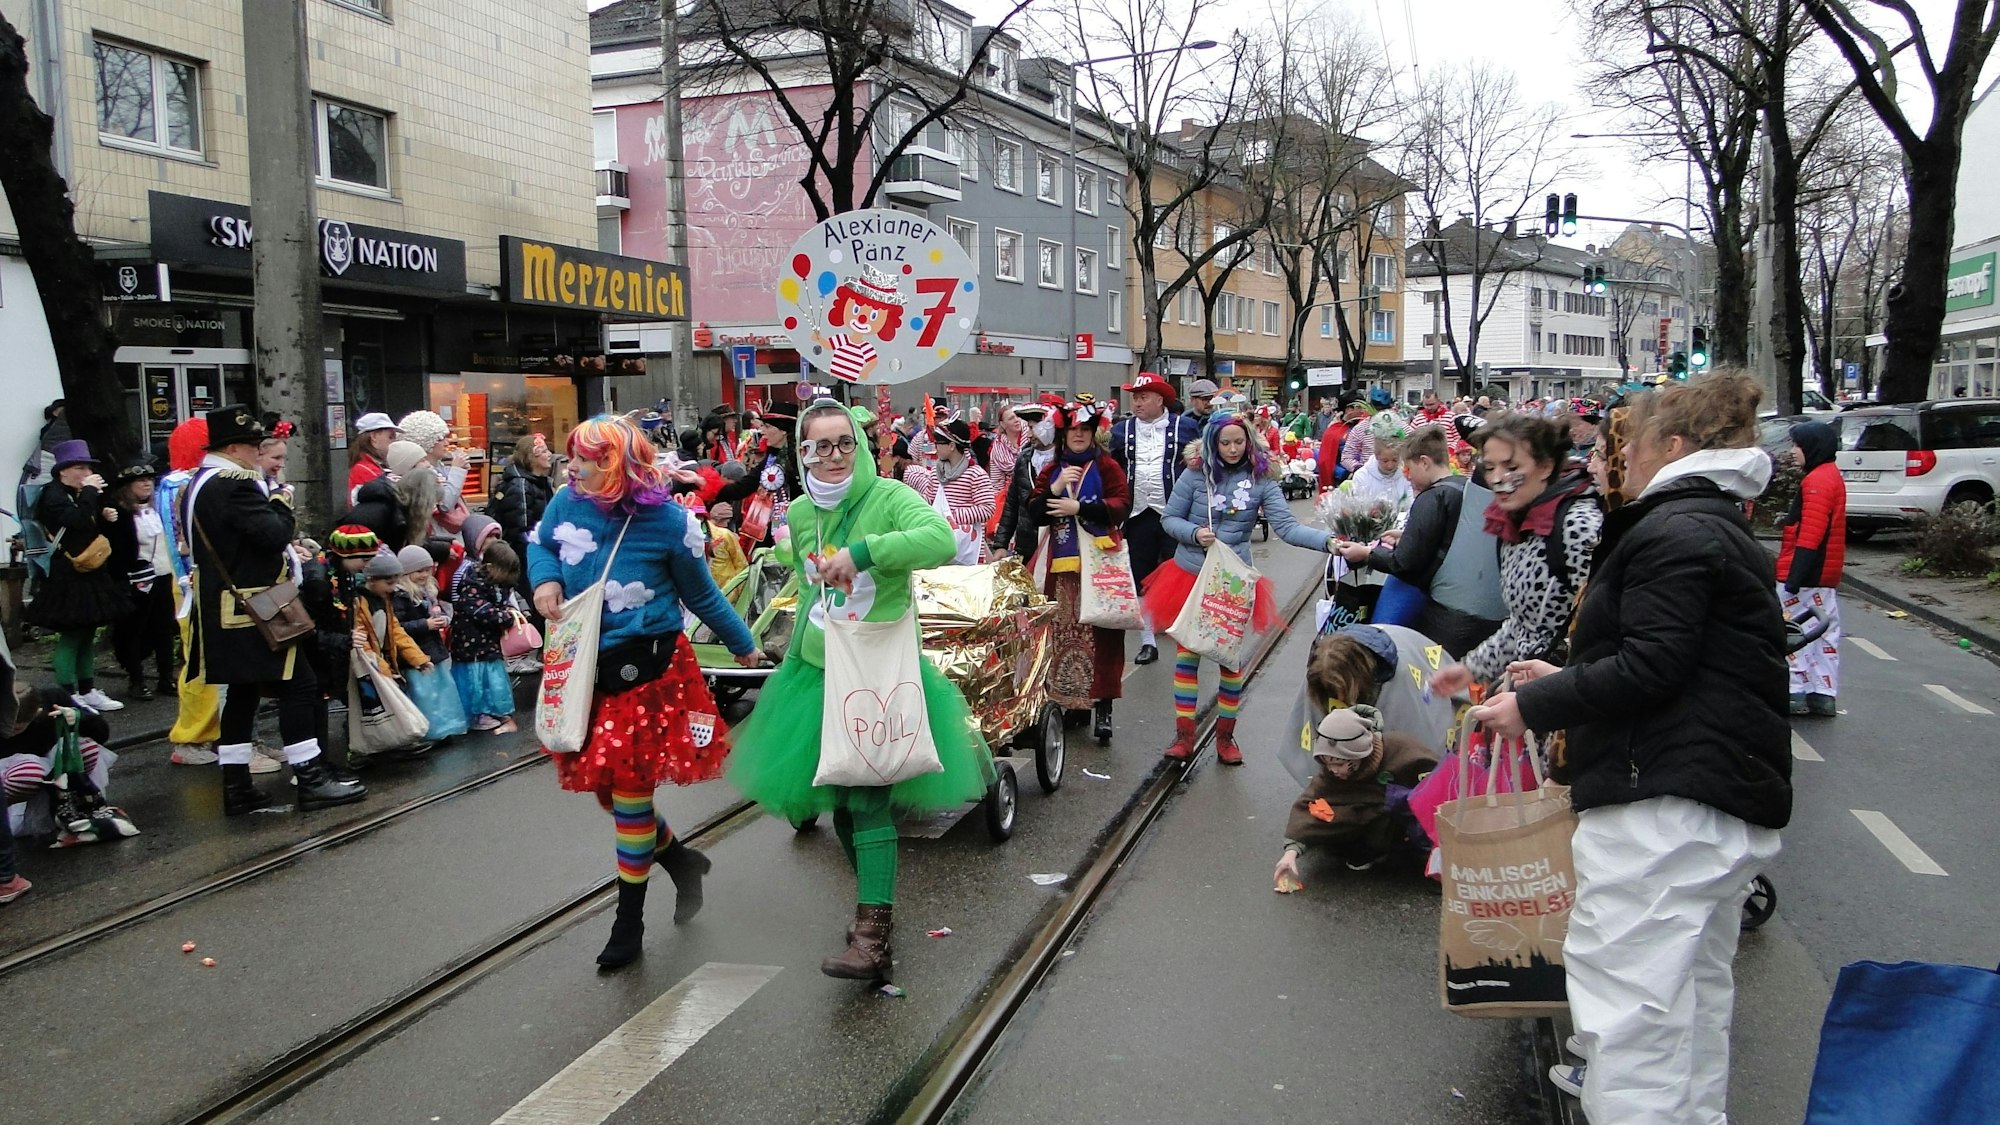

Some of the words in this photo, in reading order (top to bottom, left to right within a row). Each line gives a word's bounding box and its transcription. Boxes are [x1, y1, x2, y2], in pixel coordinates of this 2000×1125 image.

[824, 214, 937, 248] Alexianer
[357, 237, 438, 273] NATION
[851, 239, 907, 264] Pänz
[522, 242, 685, 317] Merzenich
[133, 317, 172, 328] SMOKE
[186, 319, 226, 330] NATION
[916, 278, 960, 348] 7
[1847, 365, 1855, 378] P
[852, 713, 914, 747] POLL
[1451, 858, 1550, 883] MMLISCH
[1456, 871, 1568, 901] EINKAUFEN
